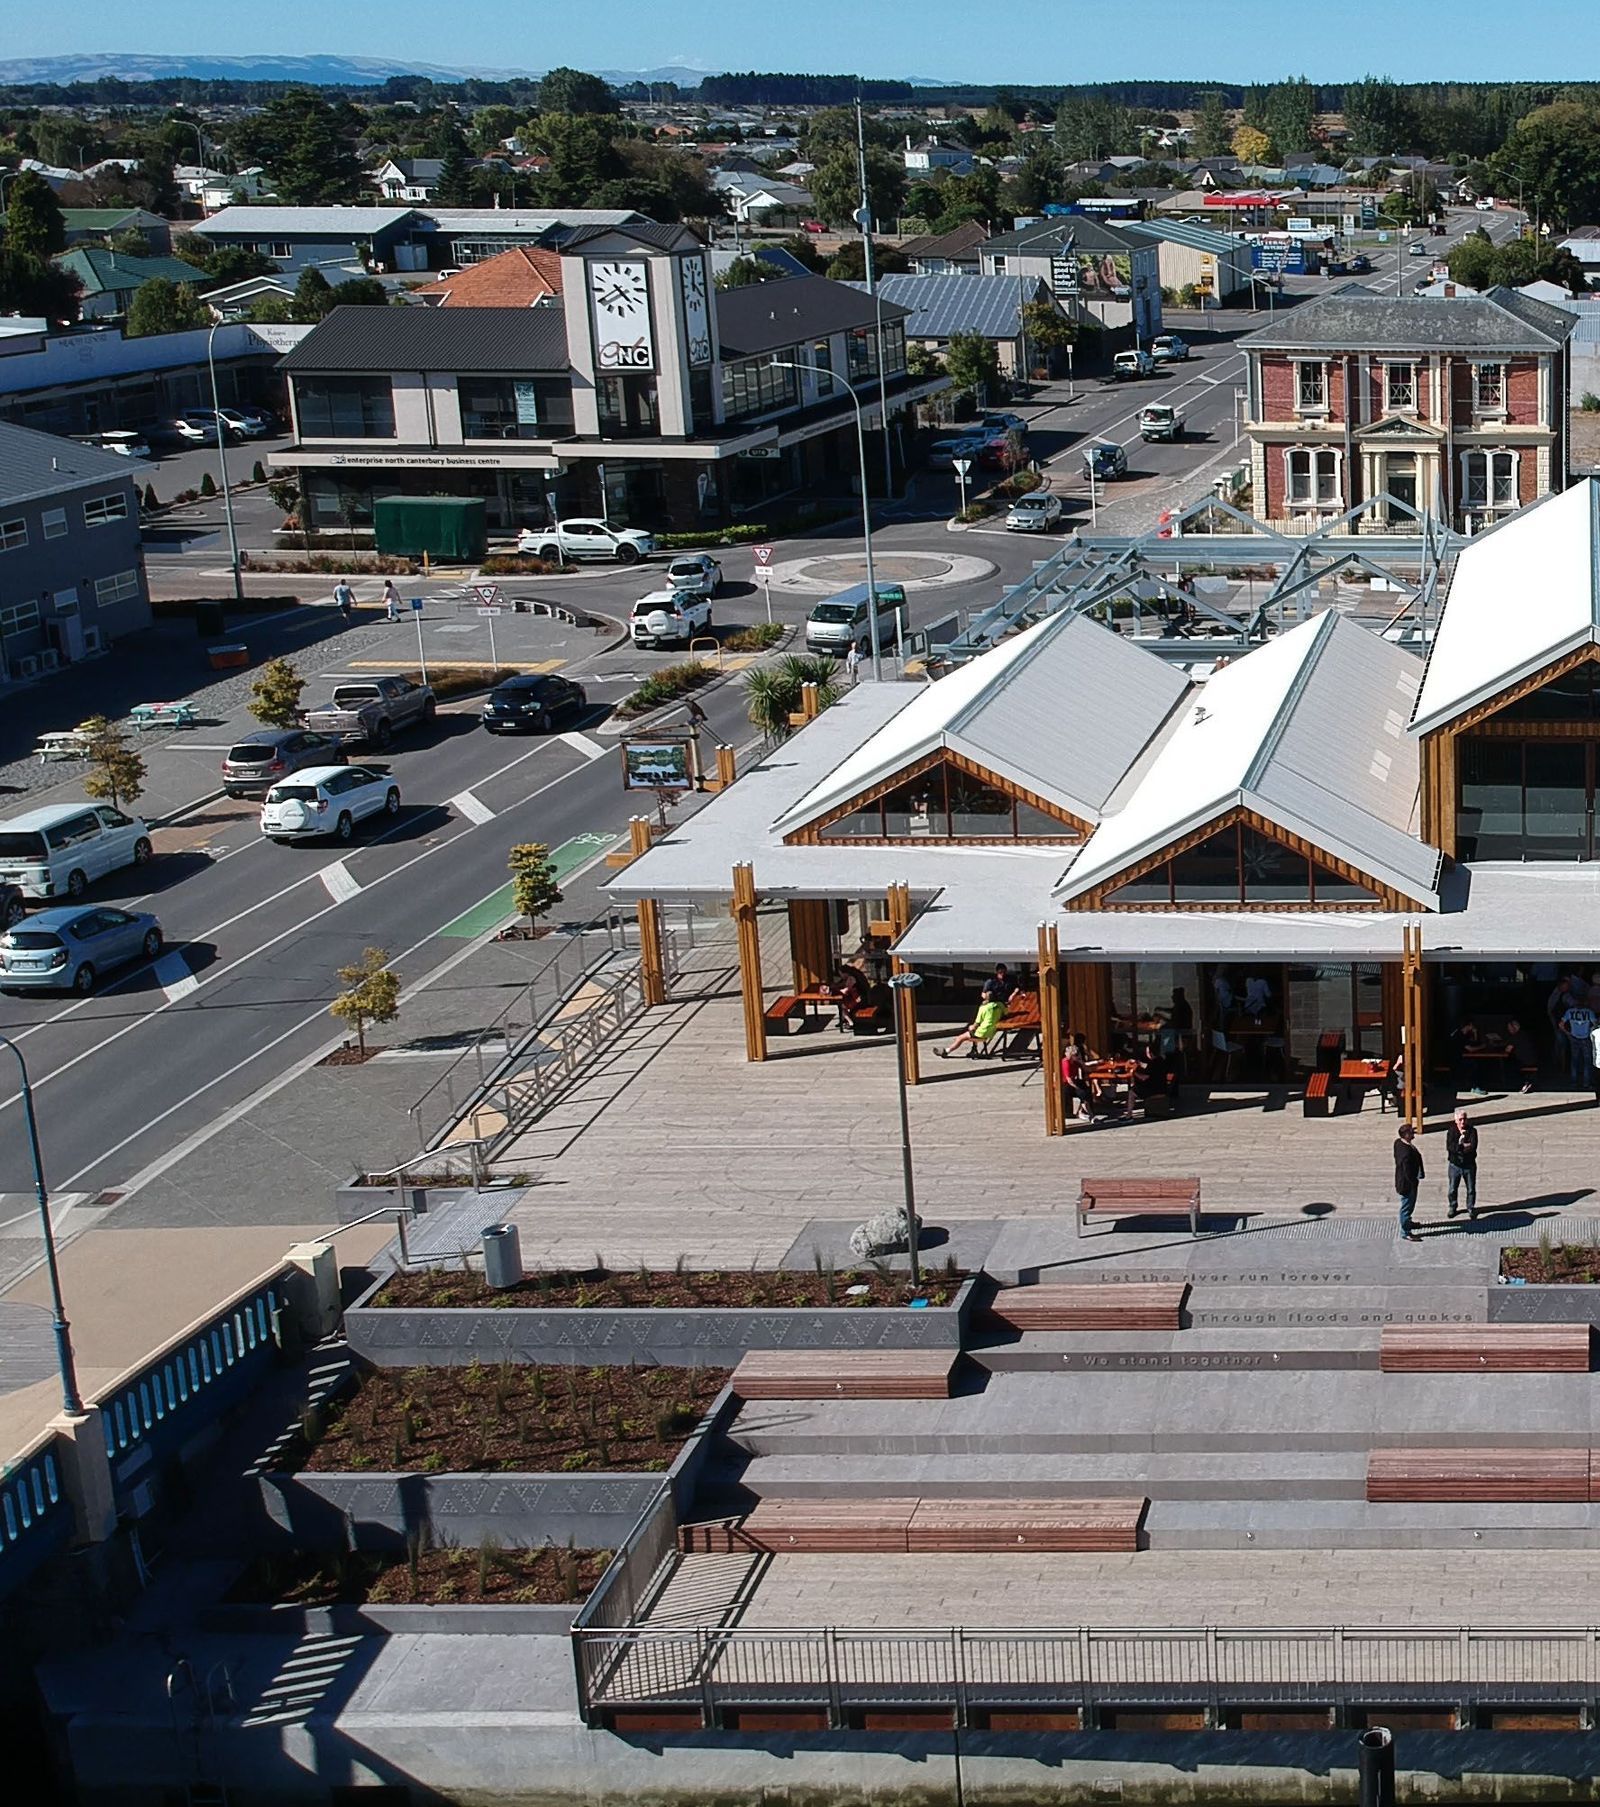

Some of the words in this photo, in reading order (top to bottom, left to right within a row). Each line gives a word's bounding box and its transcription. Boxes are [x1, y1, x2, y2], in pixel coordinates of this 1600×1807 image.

[347, 458, 383, 466] enterprise
[406, 457, 445, 466] canterbury
[1101, 1273, 1131, 1282] Let
[1142, 1273, 1170, 1282] the
[1182, 1273, 1228, 1282] river
[1239, 1273, 1270, 1282] run
[1280, 1272, 1353, 1282] forever
[1200, 1313, 1277, 1324] Through
[1288, 1312, 1351, 1323] floods
[1361, 1313, 1394, 1322] and
[1404, 1312, 1474, 1324] quakes
[1083, 1355, 1109, 1366] We
[1118, 1355, 1171, 1366] stand
[1180, 1355, 1263, 1368] together
